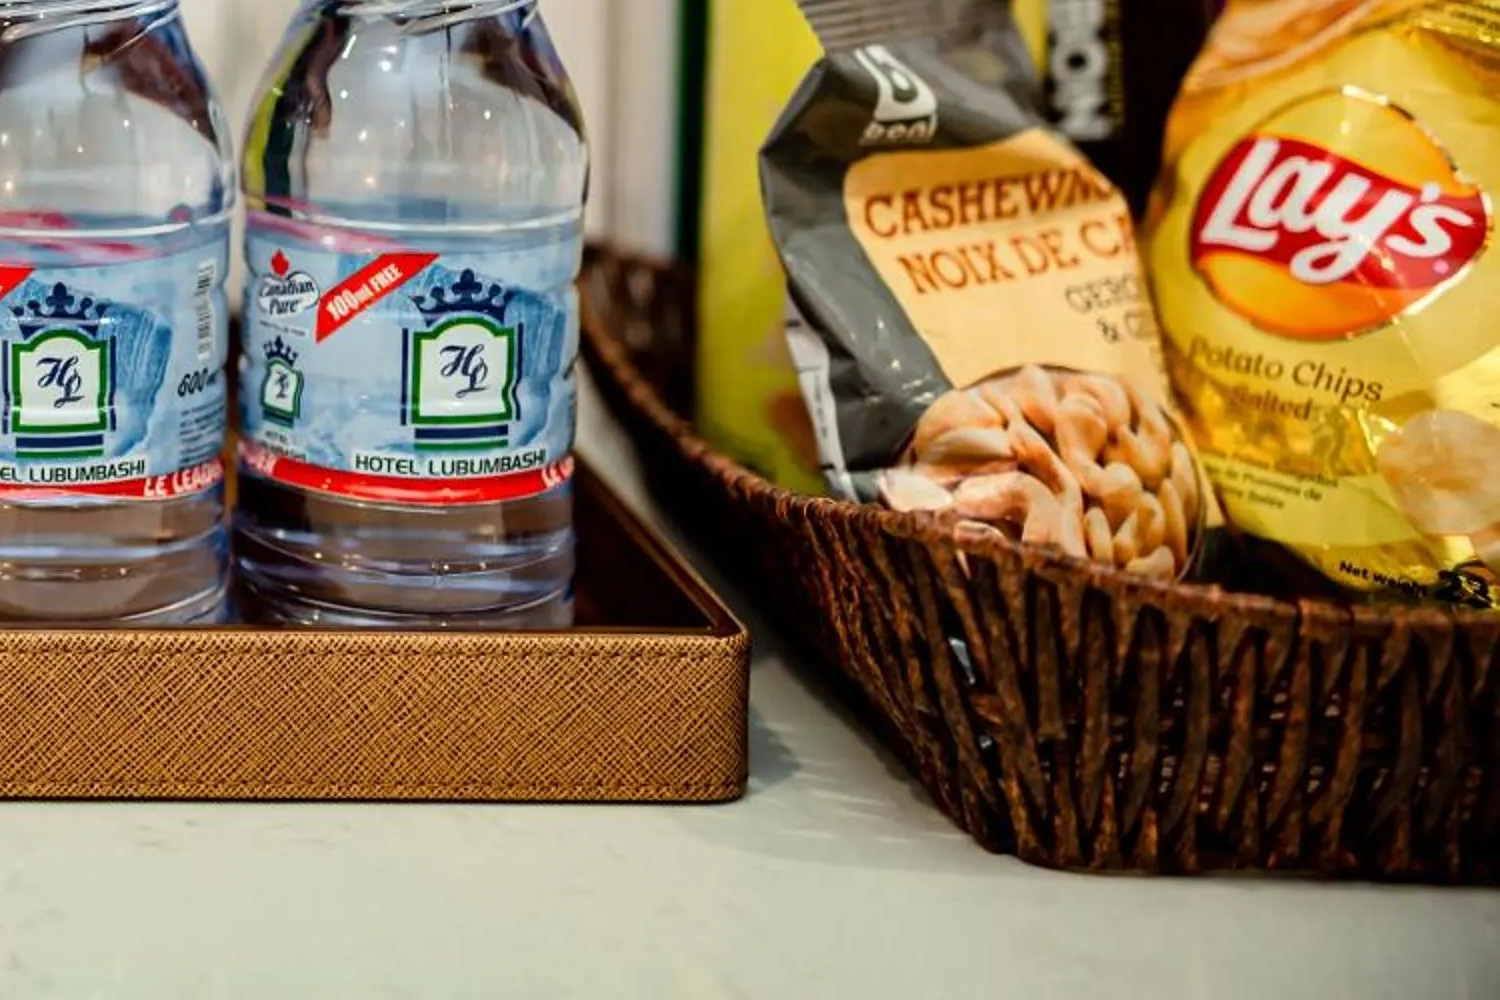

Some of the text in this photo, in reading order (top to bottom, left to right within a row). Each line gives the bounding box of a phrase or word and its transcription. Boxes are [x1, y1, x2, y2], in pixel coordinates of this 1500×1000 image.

[1201, 138, 1475, 286] Lay's
[897, 242, 1015, 294] NOIX
[1010, 230, 1080, 277] DE
[368, 263, 404, 292] FREE
[1188, 338, 1384, 404] Potato Chips
[28, 459, 146, 483] LUBUMBASHI
[355, 453, 420, 475] HOTEL
[1339, 560, 1369, 581] Net
